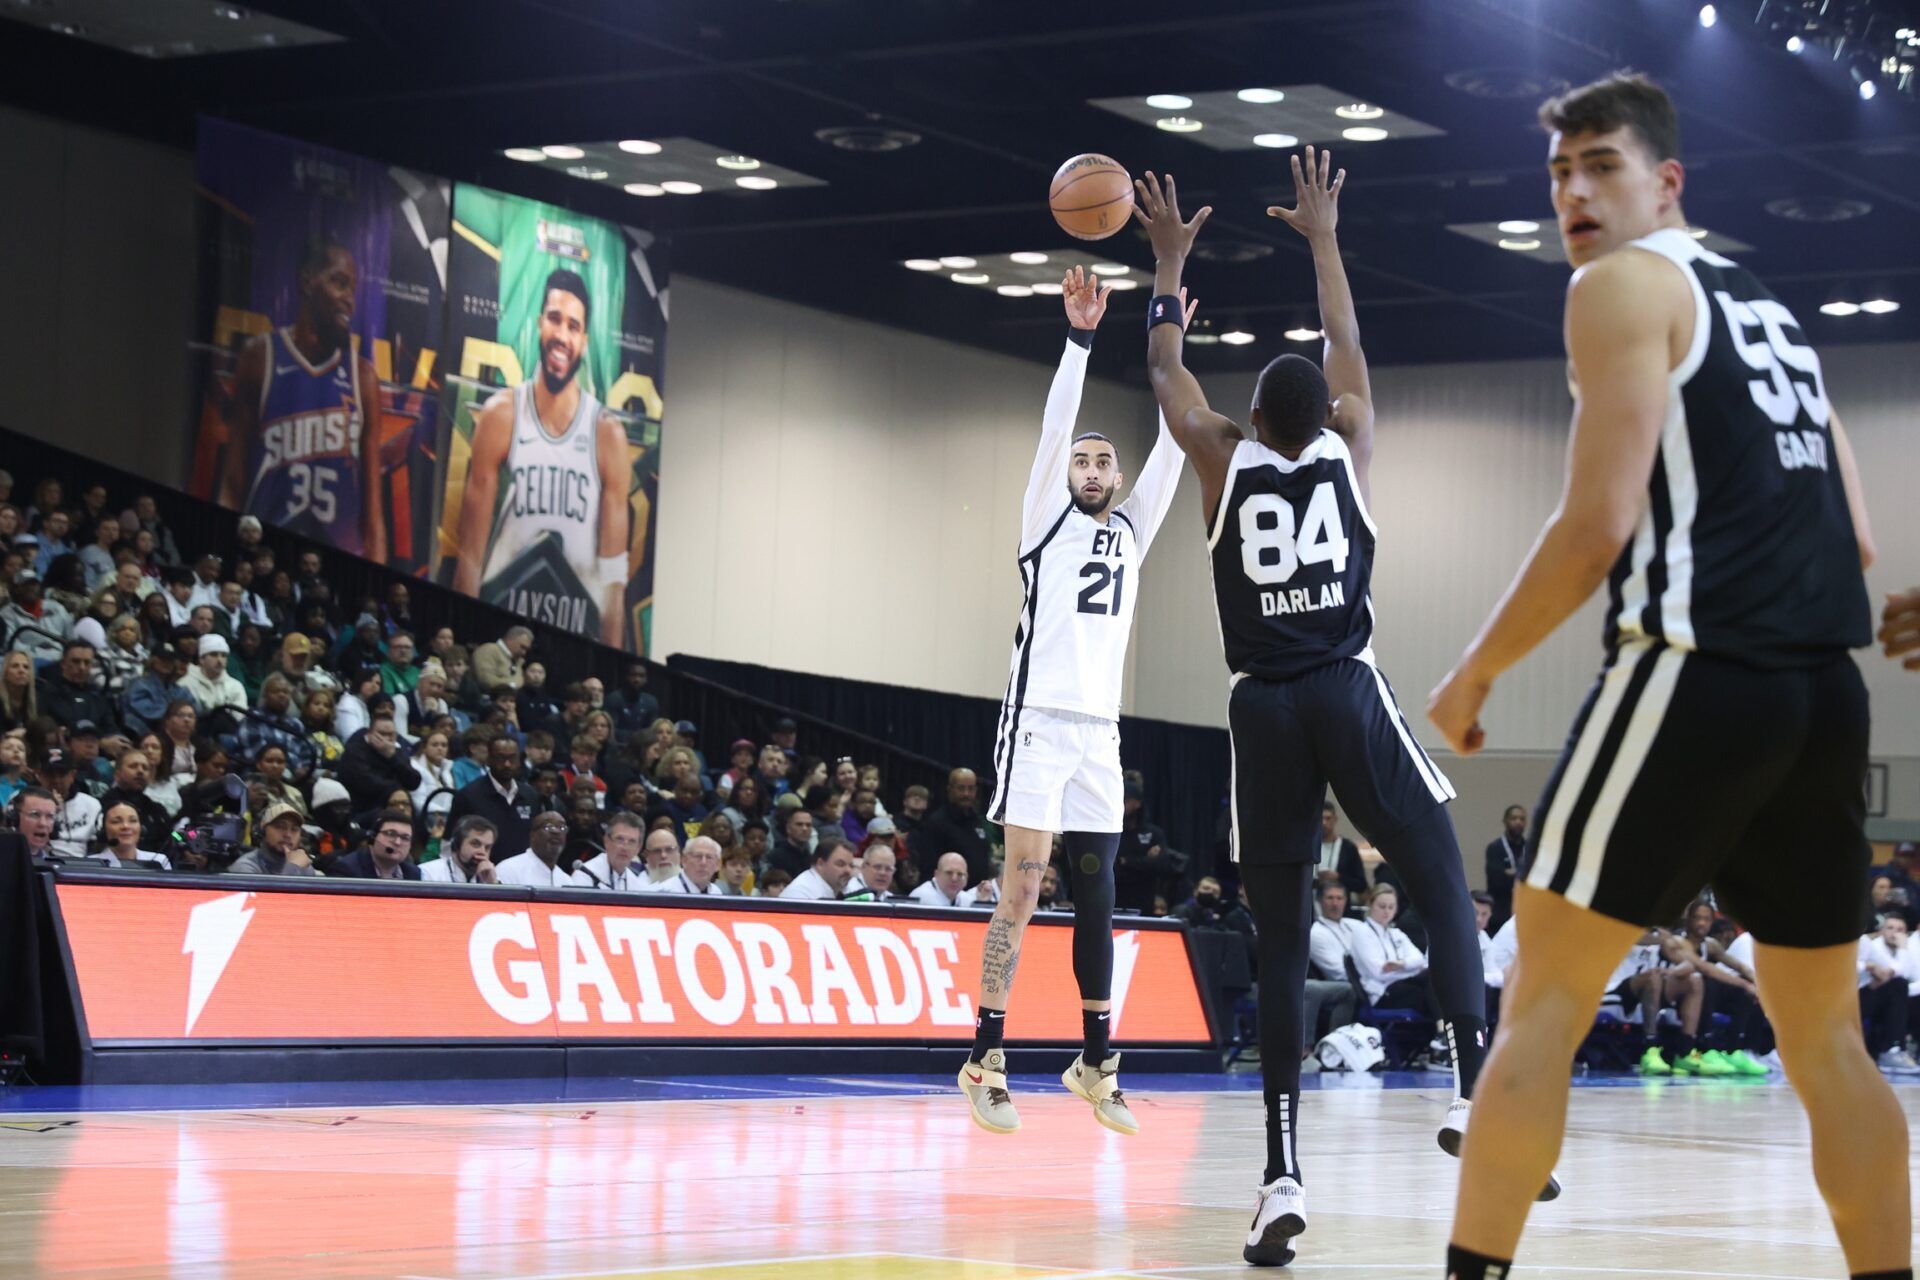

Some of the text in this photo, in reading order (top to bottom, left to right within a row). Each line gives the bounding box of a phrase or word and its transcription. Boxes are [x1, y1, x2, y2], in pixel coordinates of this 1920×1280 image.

[1713, 290, 1830, 428] 55
[264, 412, 346, 469] SUNS
[287, 463, 339, 523] 35
[514, 464, 590, 523] CELTICS
[1091, 528, 1122, 557] EYL
[1238, 481, 1350, 585] 84
[1076, 561, 1125, 616] 21
[1260, 581, 1346, 616] DARLAN
[468, 911, 978, 1026] GATORADE
